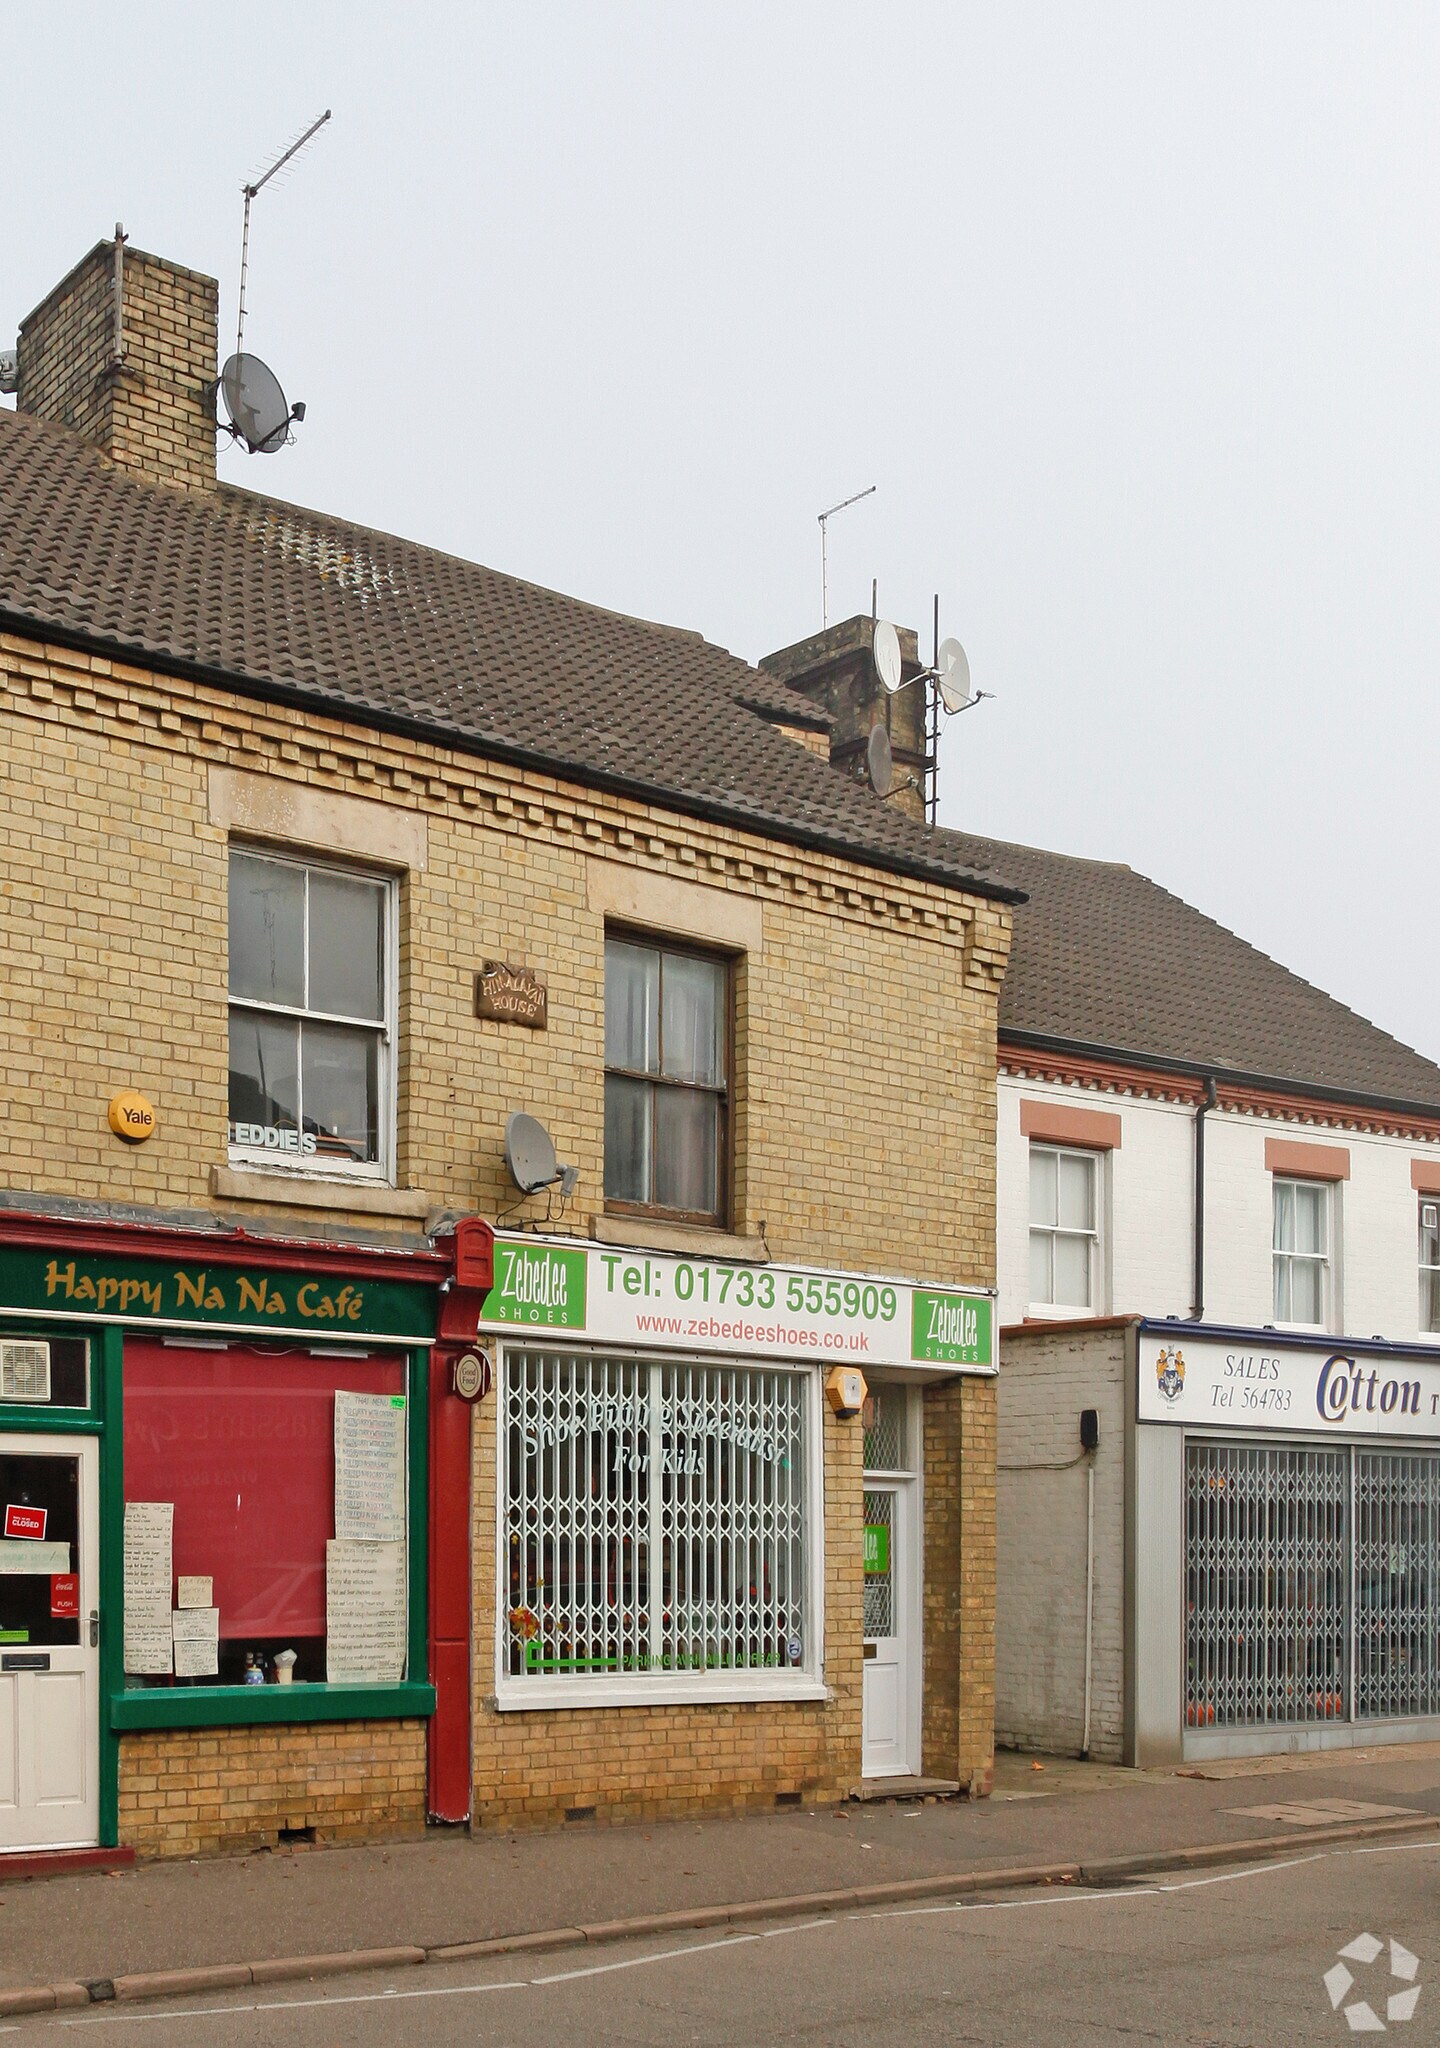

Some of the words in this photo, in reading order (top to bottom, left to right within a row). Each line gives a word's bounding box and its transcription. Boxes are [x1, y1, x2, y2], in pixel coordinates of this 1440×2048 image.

[490, 995, 537, 1018] HOUSE
[122, 1107, 152, 1126] Yale
[228, 1119, 317, 1155] EDDIES
[44, 1260, 163, 1314] Happy
[173, 1271, 227, 1310] Na
[236, 1276, 287, 1315] Na
[296, 1282, 364, 1320] Café
[500, 1250, 568, 1307] Zebedee
[600, 1254, 662, 1297] Tel:
[674, 1263, 776, 1310] 01733
[786, 1276, 898, 1322] 555909
[499, 1306, 568, 1324] SHOES
[926, 1299, 978, 1348] Zebedee
[636, 1313, 870, 1352] www.zebedeeshoes.co.uk
[925, 1347, 979, 1362] SHOES
[1223, 1354, 1281, 1381] SALES
[461, 1367, 477, 1376] Good
[462, 1375, 476, 1384] Food
[1210, 1384, 1235, 1408] Tel
[1240, 1386, 1293, 1412] 564783
[1316, 1354, 1422, 1423] Cotton
[520, 1415, 582, 1460] Shoe
[677, 1401, 787, 1467] Specialist
[611, 1445, 651, 1474] For
[659, 1448, 706, 1475] Kids
[12, 1519, 39, 1529] CLOSED
[621, 1653, 671, 1667] PARKING
[675, 1652, 733, 1667] AVAILABLE
[734, 1651, 749, 1666] AT
[751, 1651, 781, 1667] REAR
